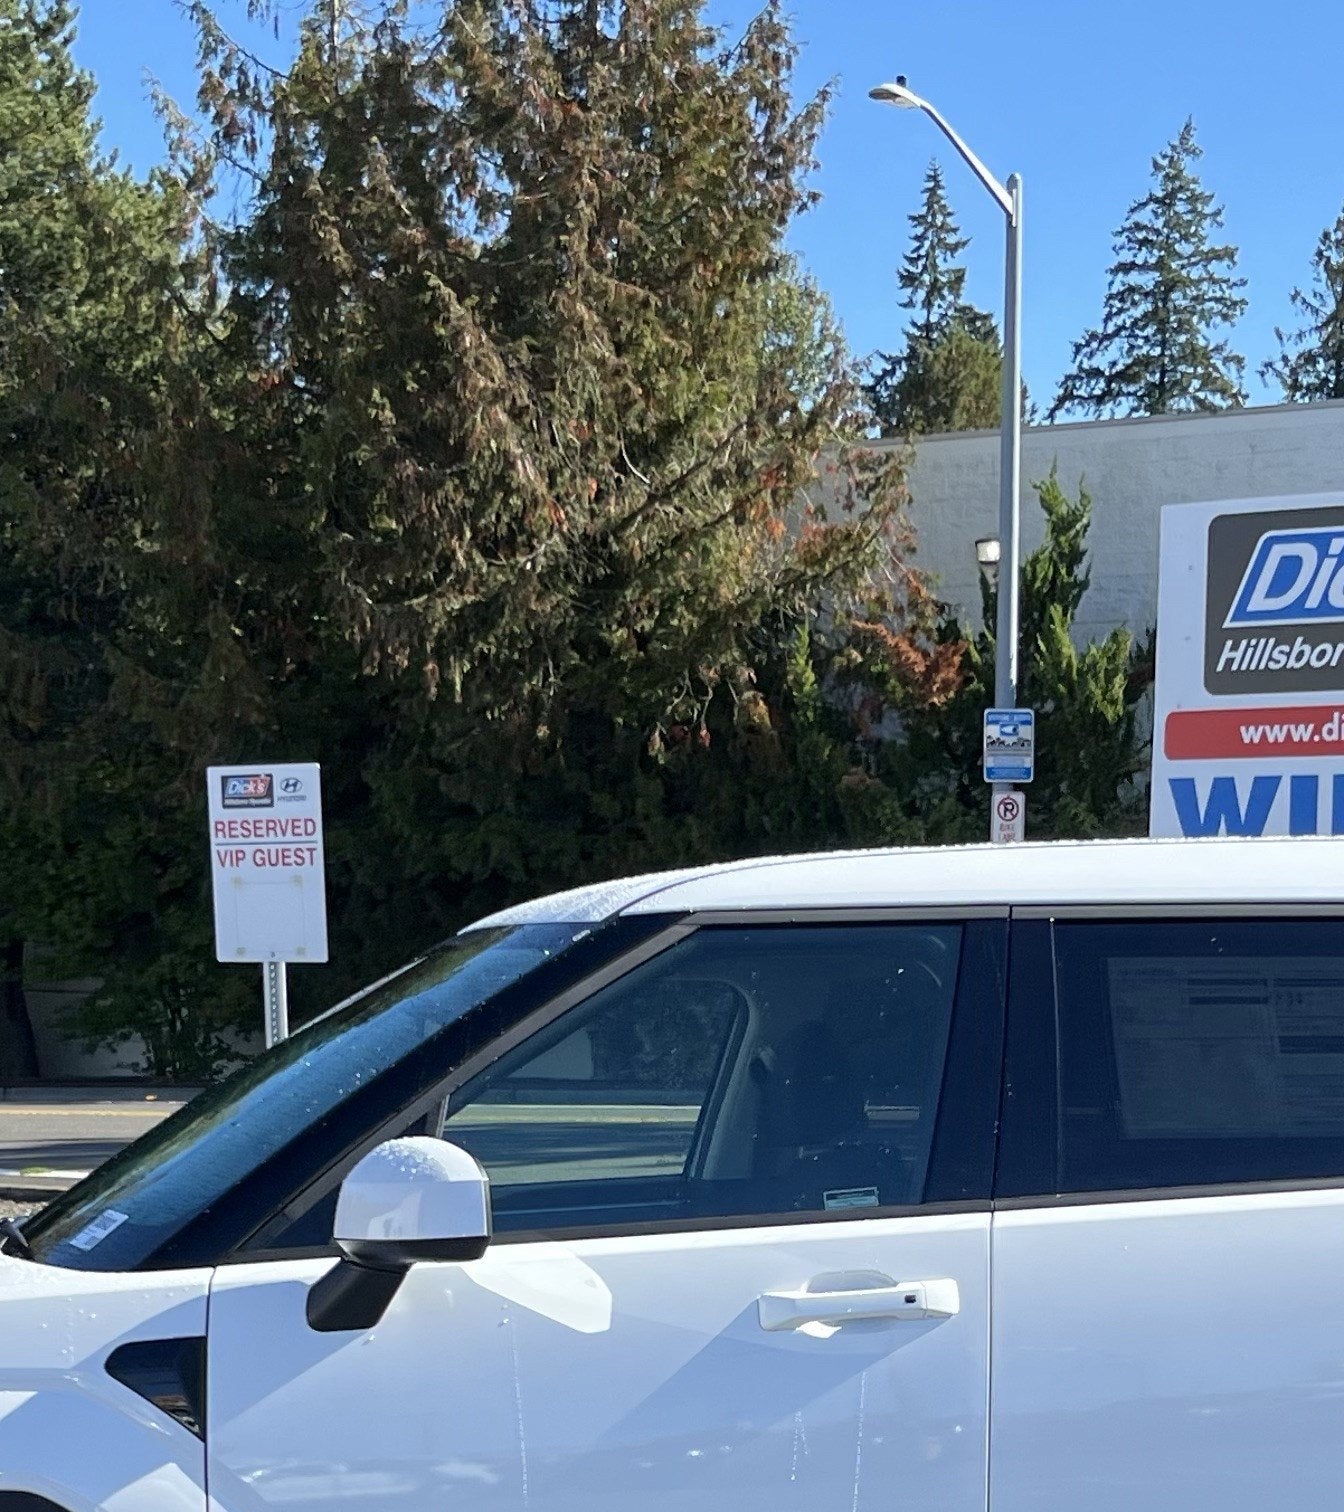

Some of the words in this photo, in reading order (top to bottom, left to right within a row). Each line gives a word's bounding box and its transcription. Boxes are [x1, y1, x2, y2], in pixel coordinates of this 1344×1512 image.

[214, 818, 317, 839] RESERVED
[216, 849, 246, 868] VIP
[252, 847, 317, 868] GUEST
